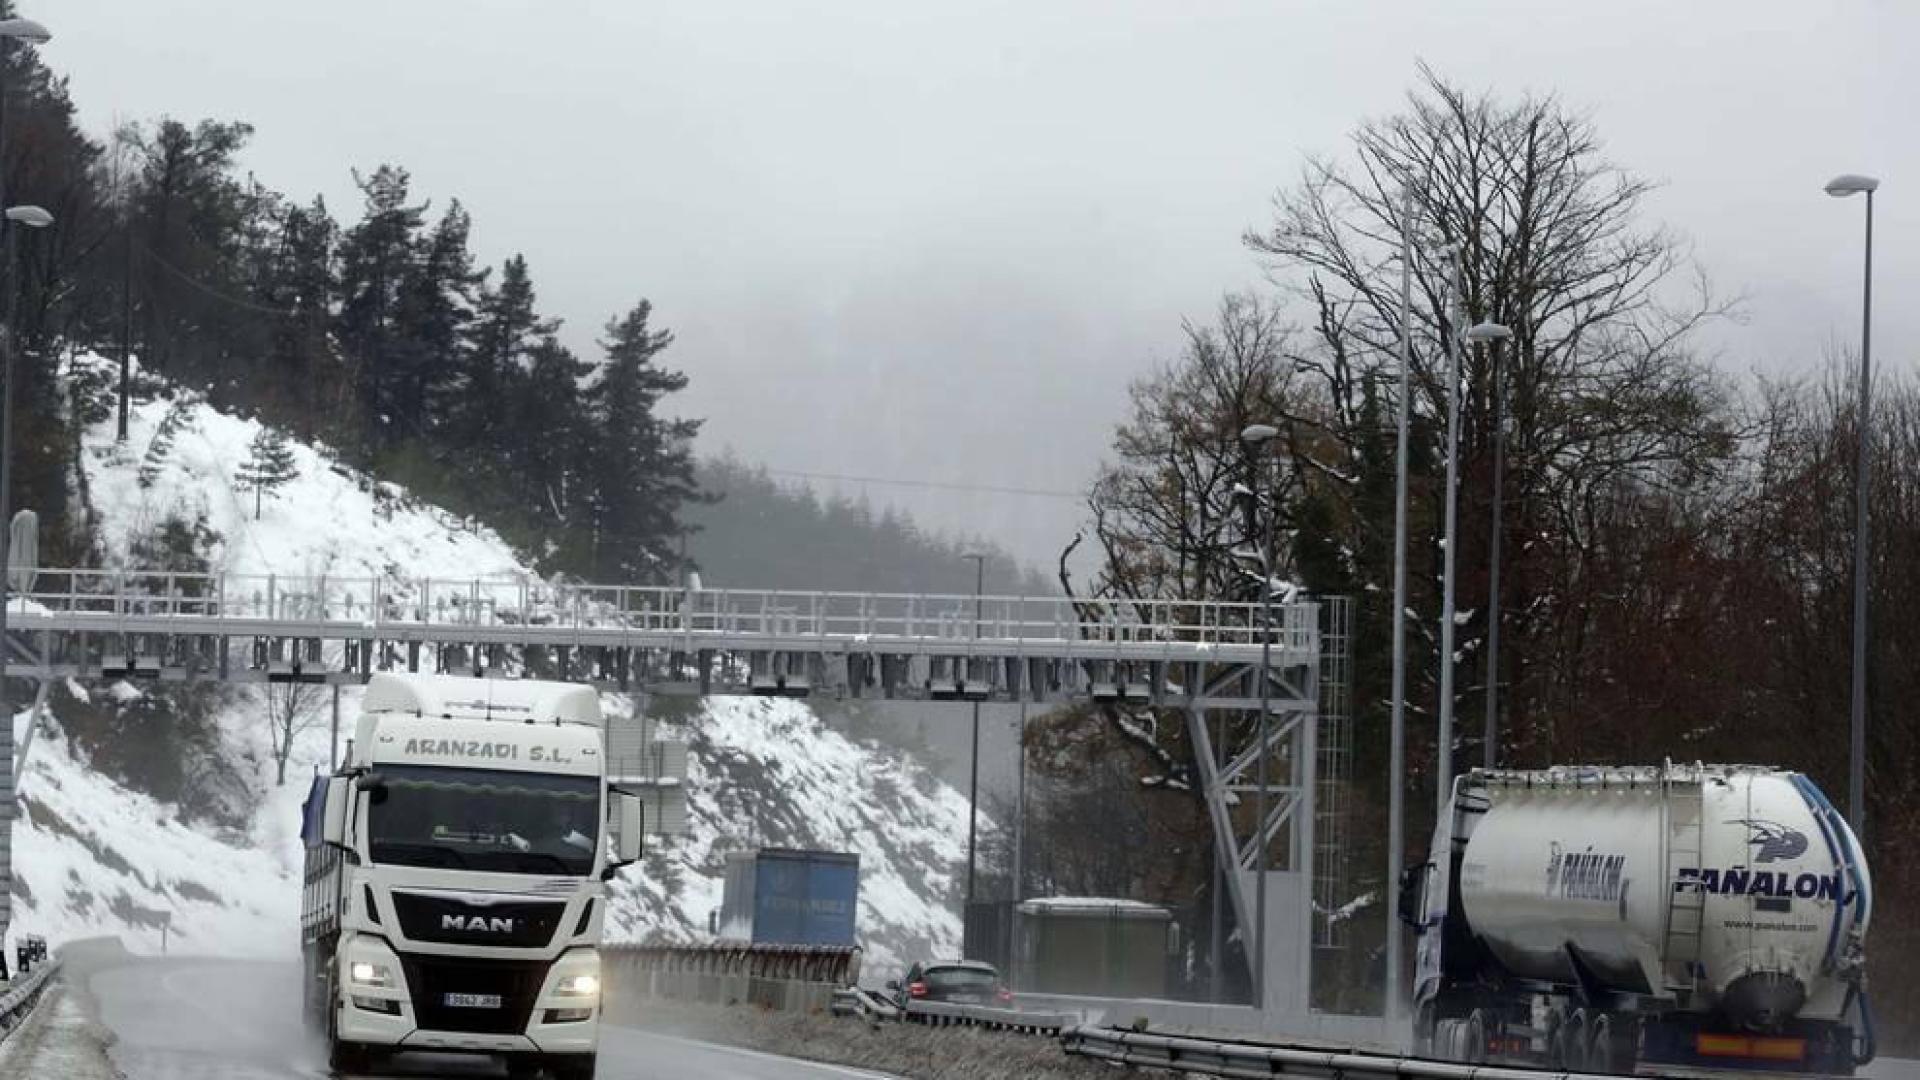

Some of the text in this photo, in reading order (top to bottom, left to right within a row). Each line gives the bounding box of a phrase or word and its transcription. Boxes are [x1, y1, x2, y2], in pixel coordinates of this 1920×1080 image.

[404, 738, 518, 761] ARANZADI
[1675, 865, 1843, 900] PAÑALON
[441, 914, 513, 934] MAN
